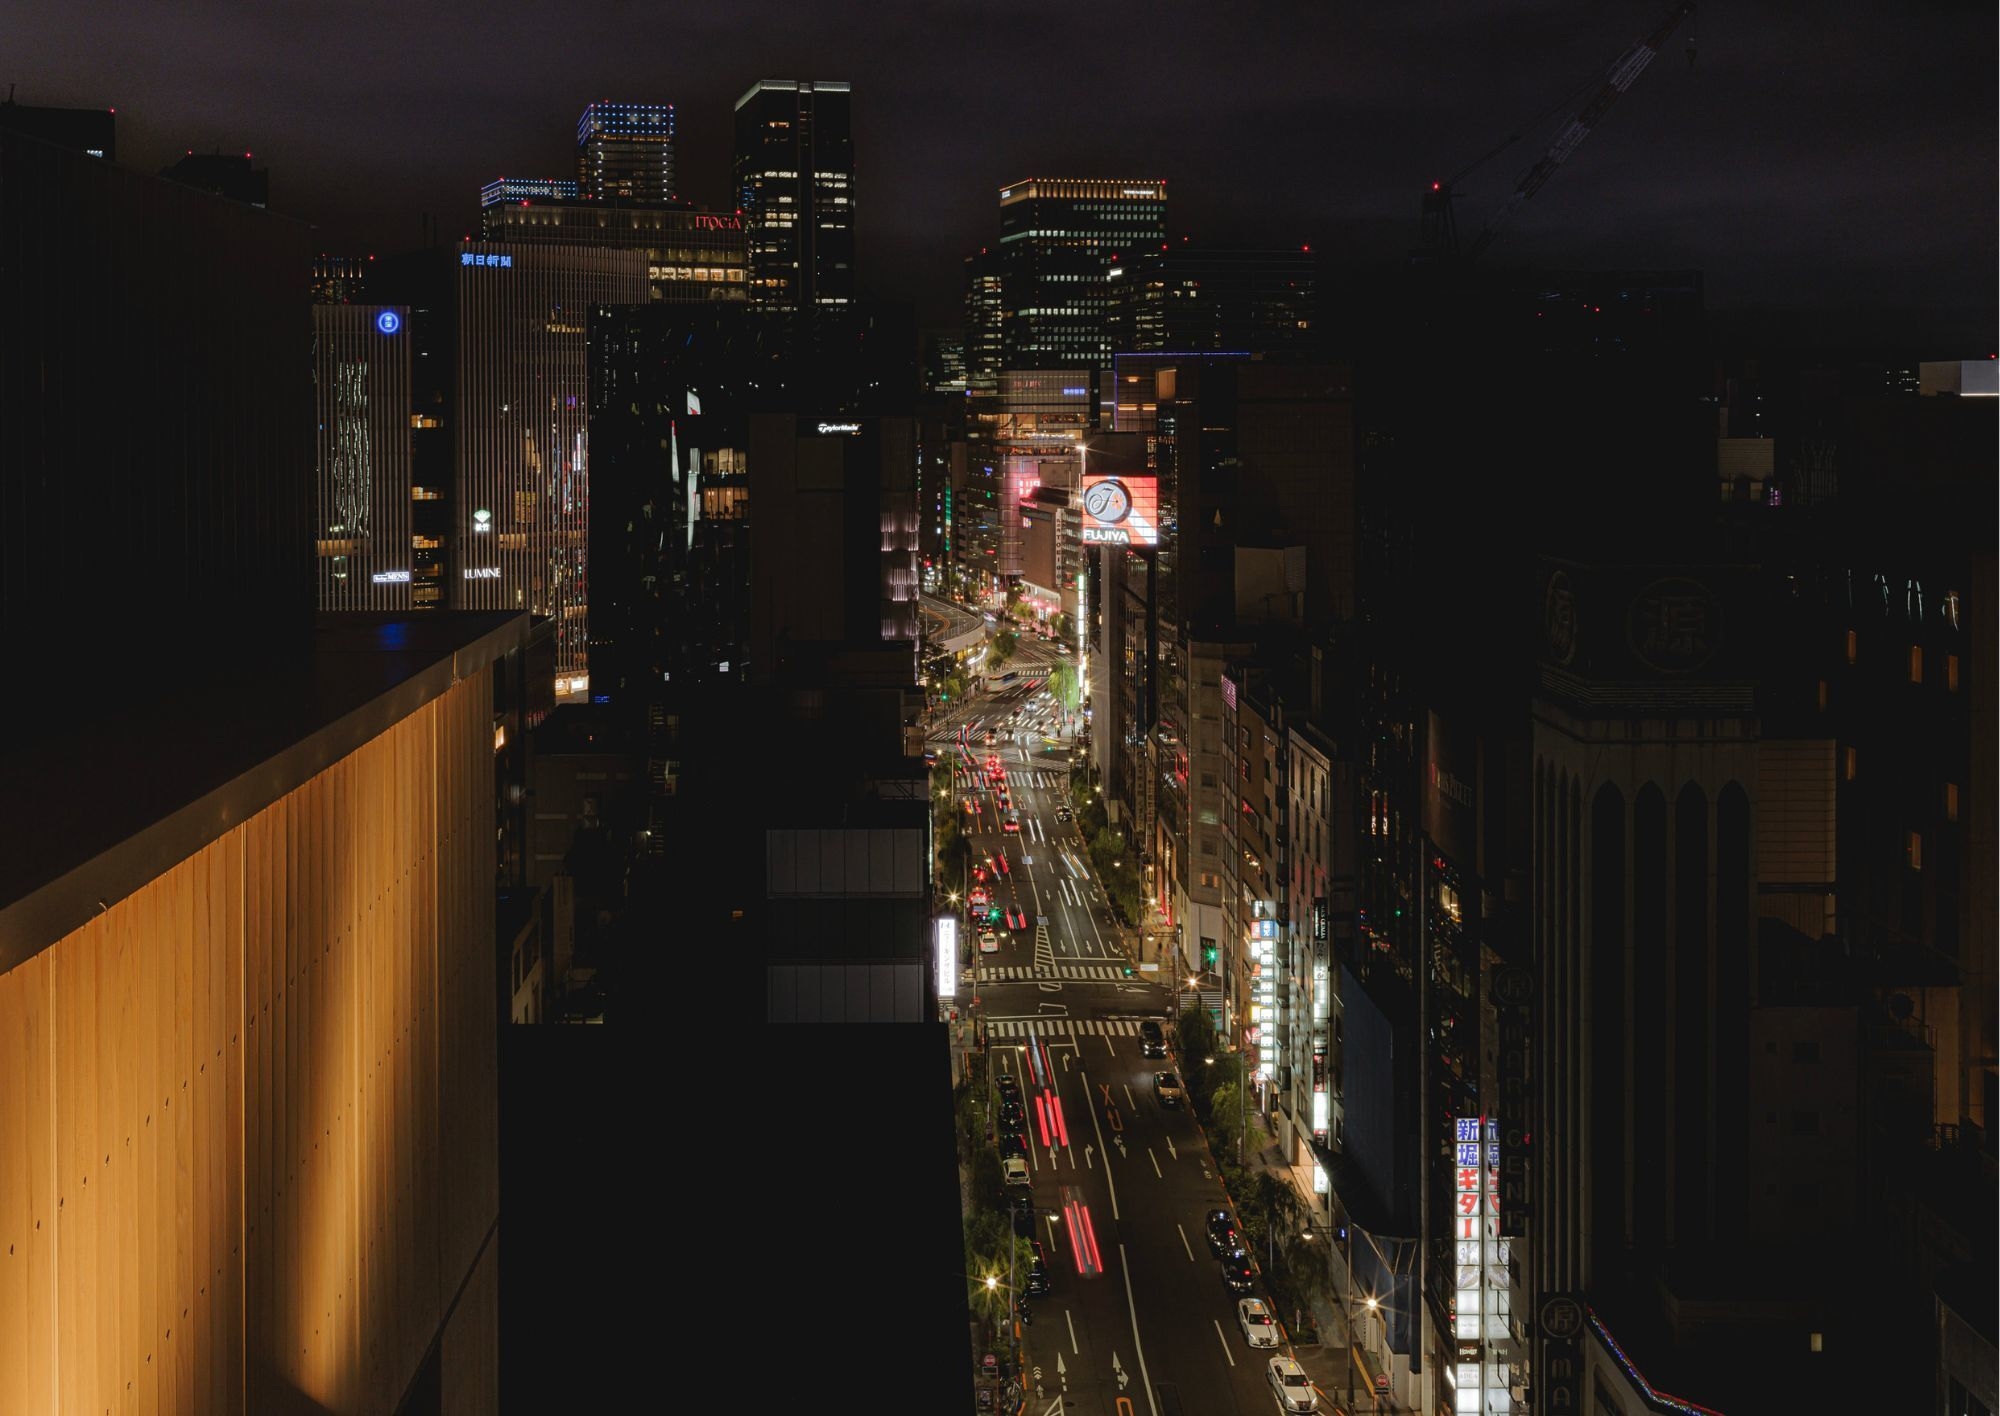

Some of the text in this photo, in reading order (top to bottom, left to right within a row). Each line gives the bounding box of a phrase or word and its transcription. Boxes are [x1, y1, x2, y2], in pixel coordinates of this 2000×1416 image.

[461, 253, 511, 267] 朝日新聞
[1083, 529, 1129, 542] FUJIYA
[464, 568, 501, 579] LUMINE
[1457, 1119, 1479, 1239] 新堀ギター
